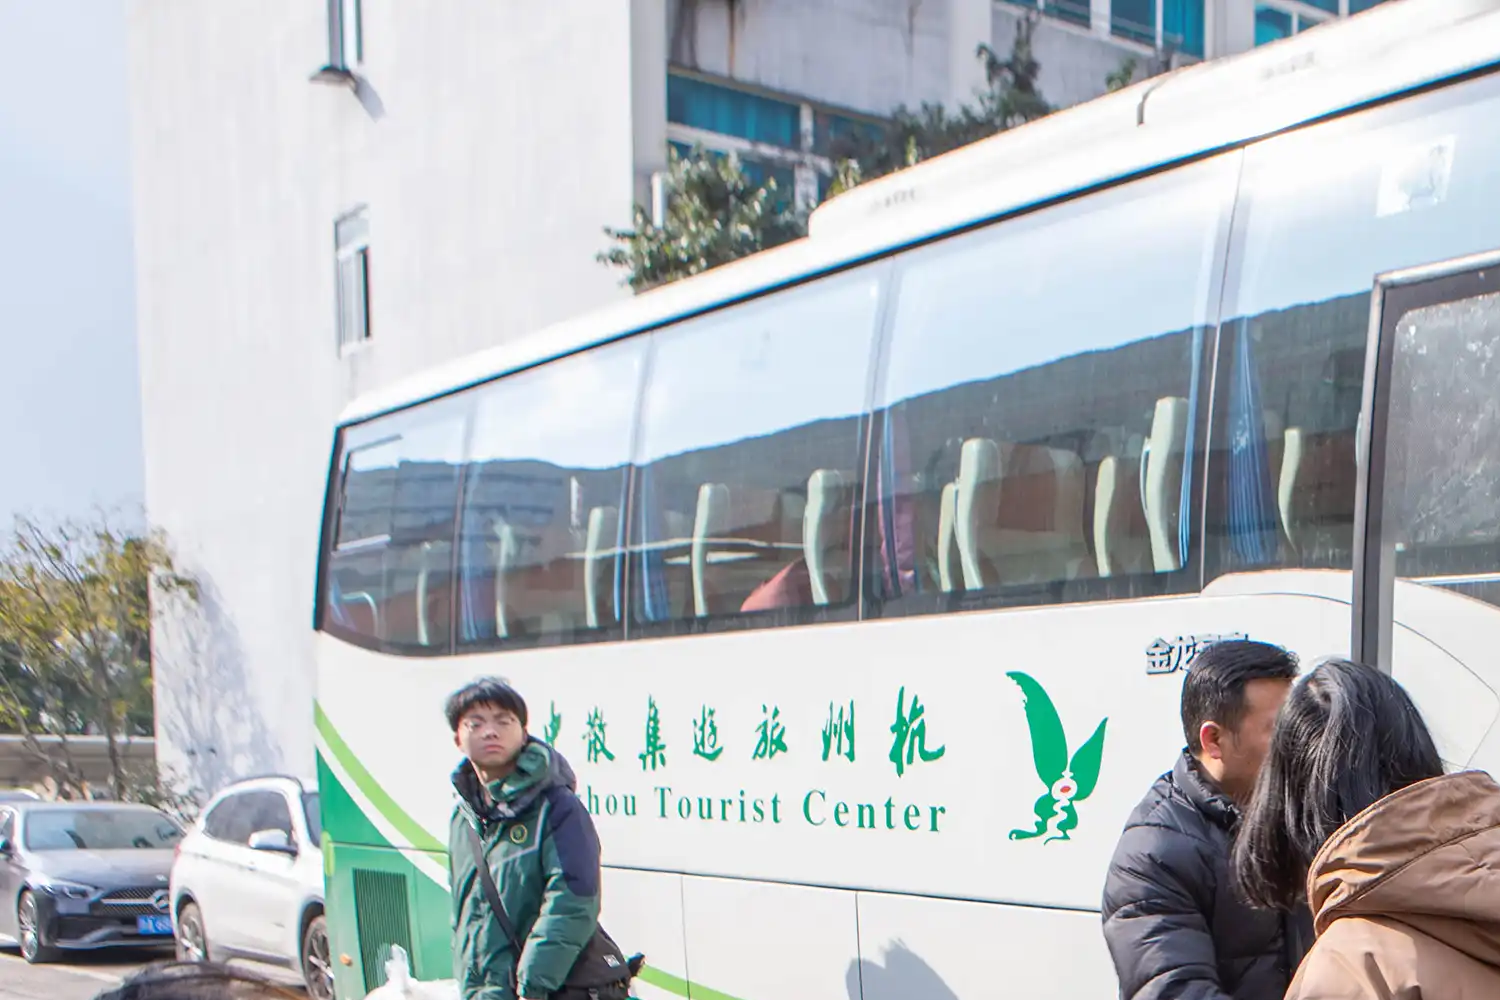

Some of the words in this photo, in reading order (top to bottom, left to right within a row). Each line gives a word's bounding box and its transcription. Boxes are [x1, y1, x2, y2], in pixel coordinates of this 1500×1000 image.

[576, 785, 636, 815] hou
[654, 786, 782, 824] Tourist
[803, 789, 946, 832] Center
